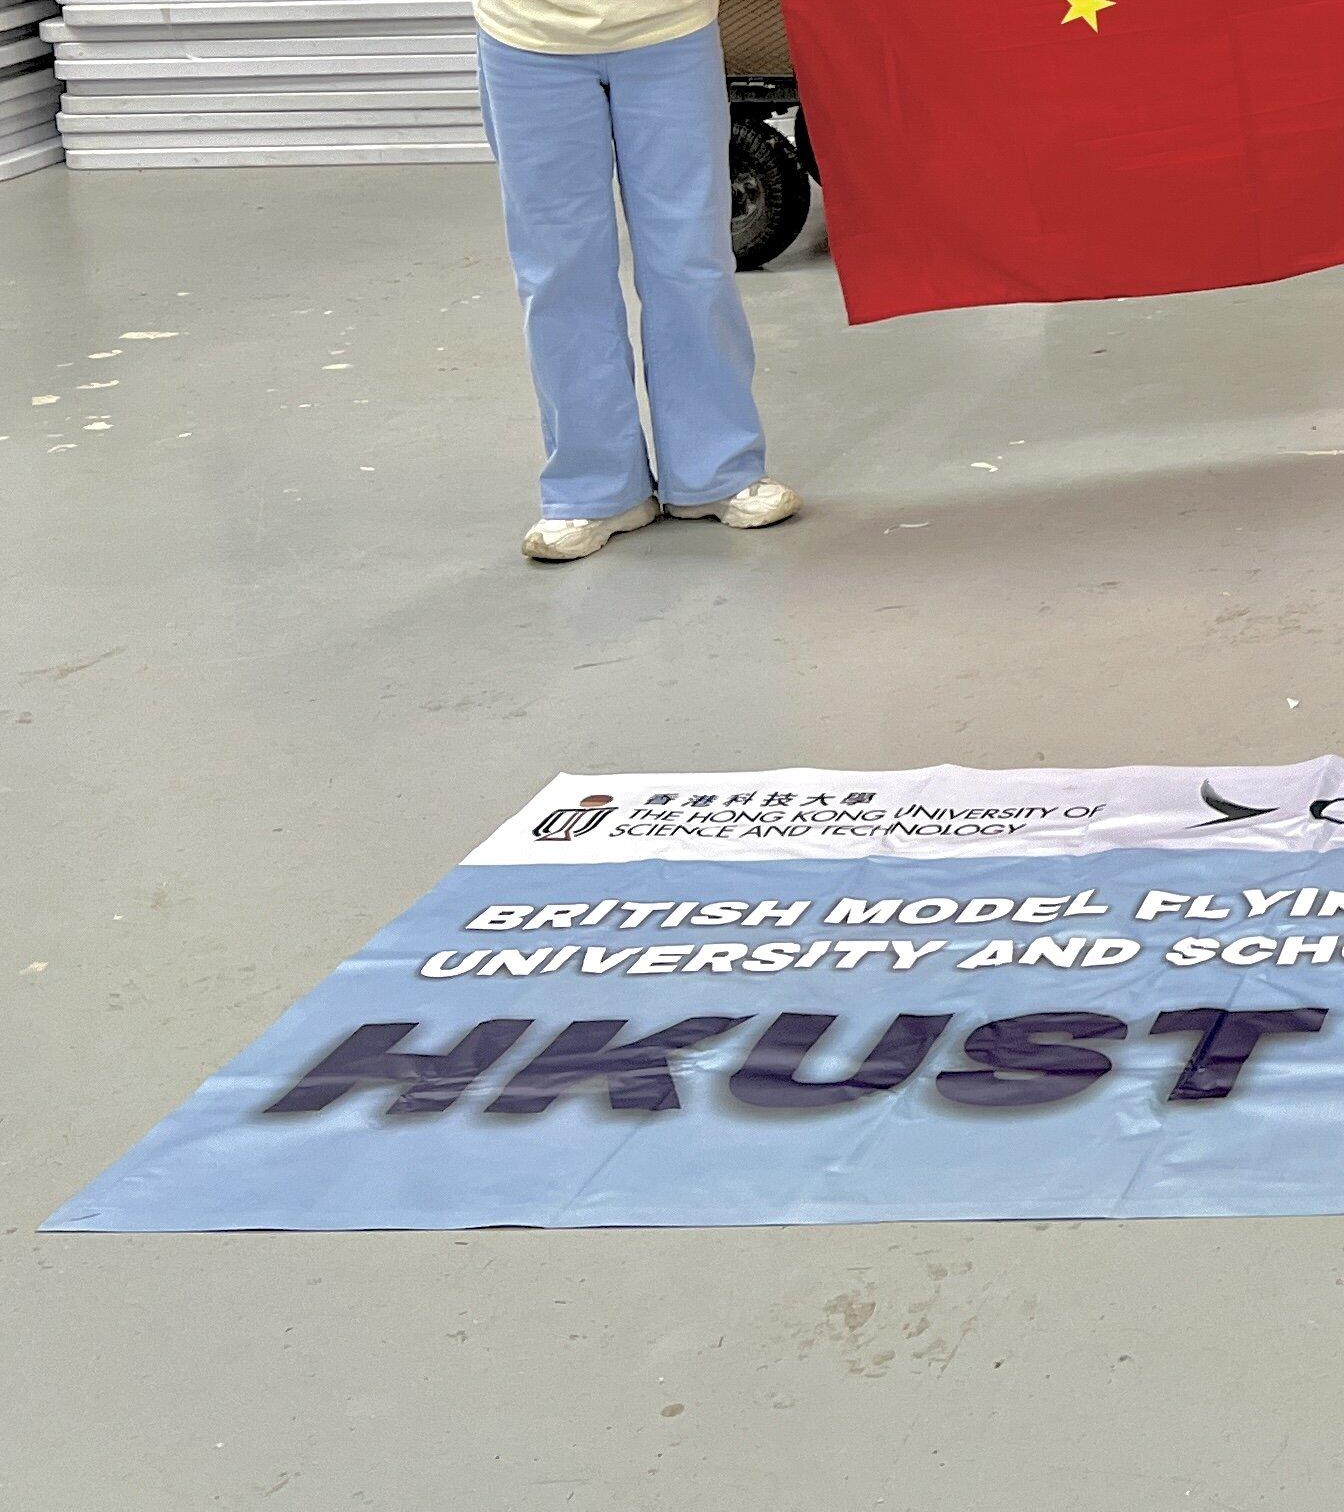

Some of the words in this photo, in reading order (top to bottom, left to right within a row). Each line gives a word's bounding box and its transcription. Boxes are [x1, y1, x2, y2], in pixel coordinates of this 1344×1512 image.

[628, 809, 684, 823] THE
[690, 809, 786, 823] HONG
[792, 809, 886, 823] KONG
[894, 803, 1062, 821] UNIVERSITY
[1068, 803, 1106, 819] OF
[644, 791, 876, 807] 香港科技大學
[609, 824, 739, 838] SCIENCE
[748, 824, 812, 838] AND
[821, 824, 1026, 838] TECHNOLOGY
[465, 898, 813, 931] BRITISH
[824, 889, 1110, 926] MODEL
[419, 939, 946, 978] UNIVERSITY
[956, 938, 1143, 970] AND
[262, 1005, 1330, 1116] HKUST
